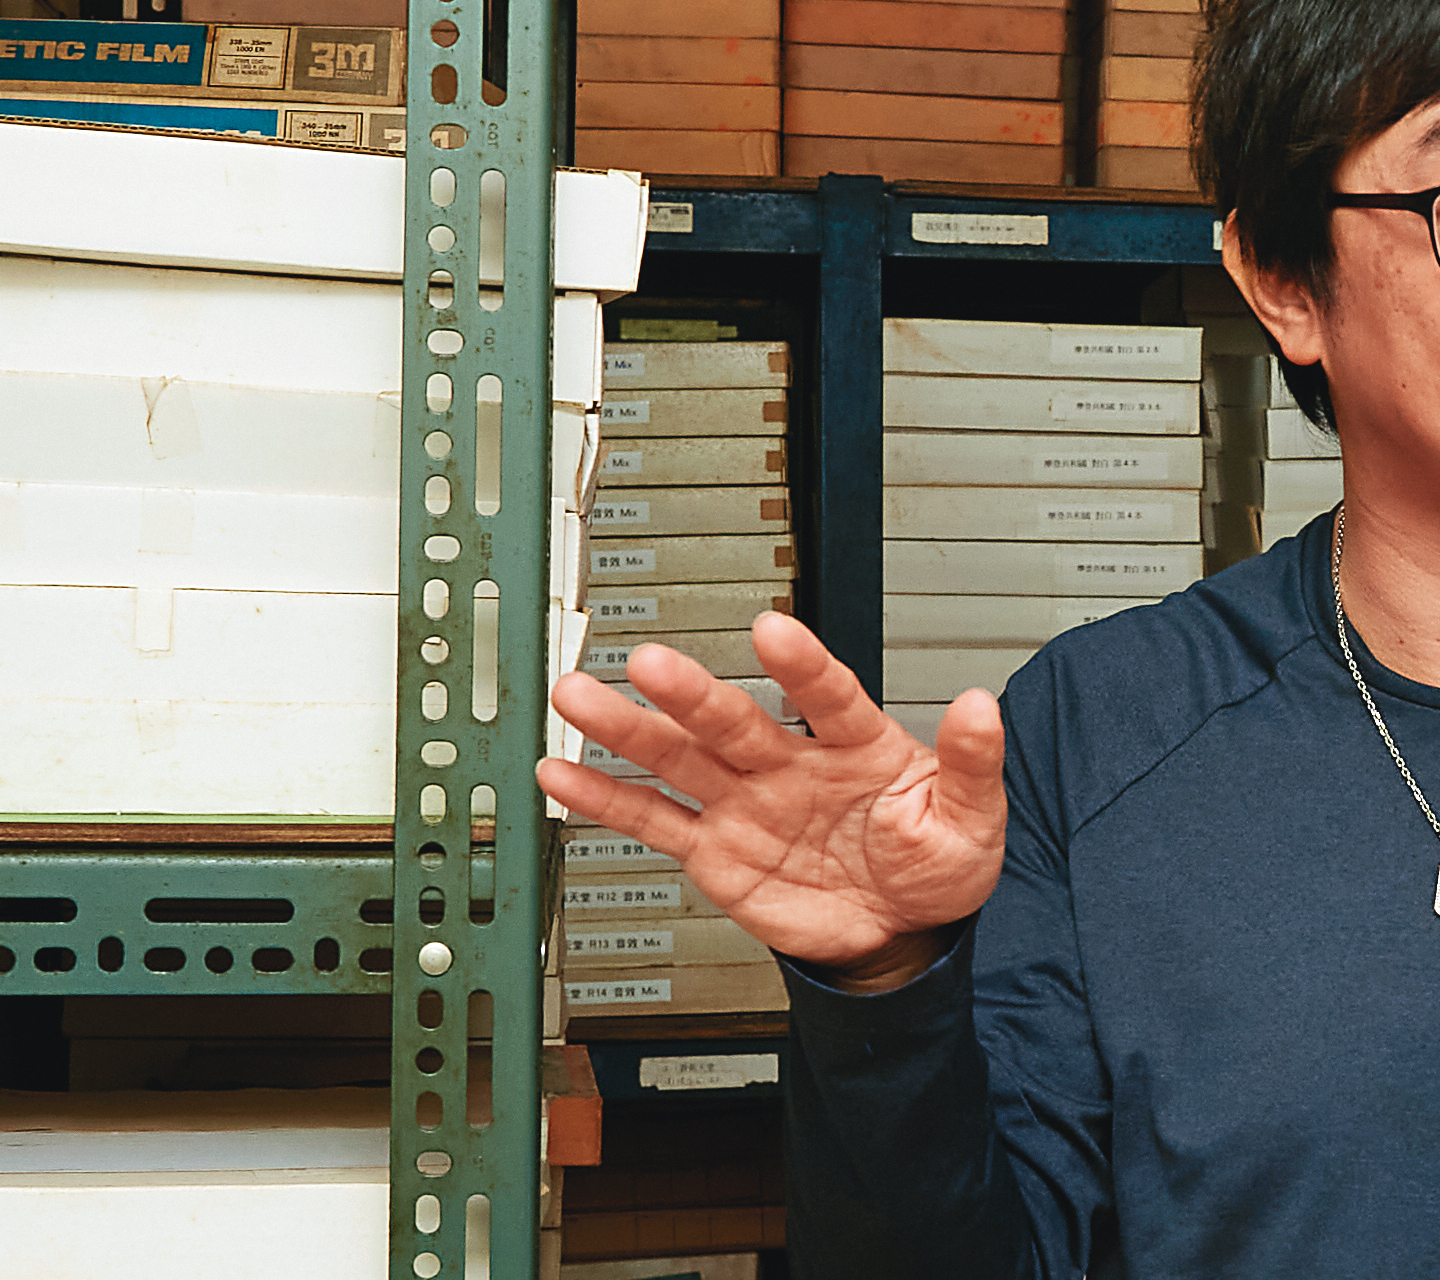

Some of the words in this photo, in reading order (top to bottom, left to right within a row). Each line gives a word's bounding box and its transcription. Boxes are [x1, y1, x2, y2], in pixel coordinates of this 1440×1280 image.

[95, 42, 191, 64] FILM
[308, 42, 376, 79] 3M
[620, 409, 637, 417] Mix
[613, 459, 630, 467] Mix
[620, 509, 637, 517] Mix
[626, 557, 643, 566] Mix
[628, 605, 646, 614] Mix
[651, 892, 668, 900] Mix
[644, 939, 661, 947] Mix
[642, 987, 659, 995] Mix
